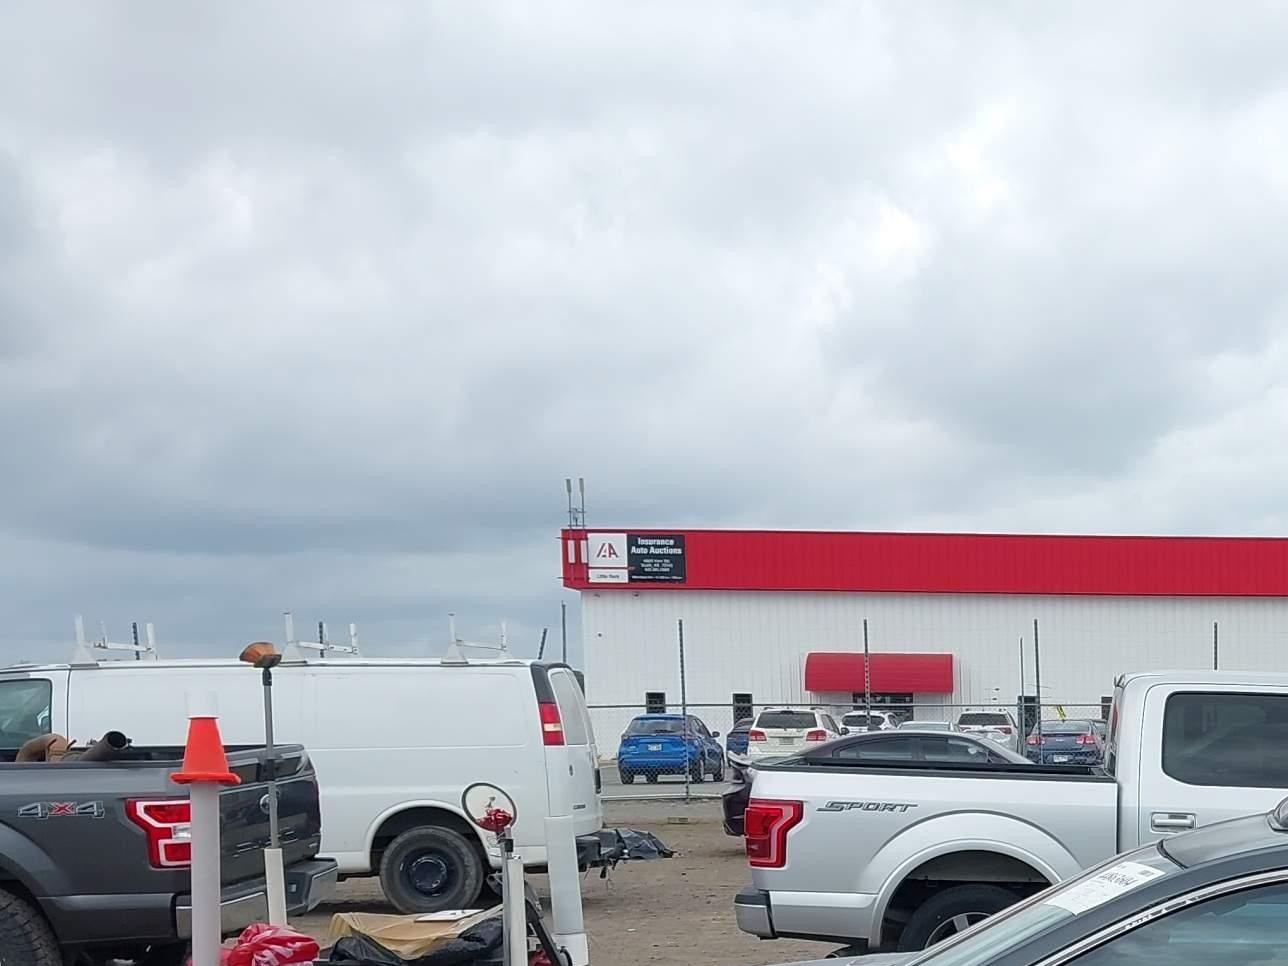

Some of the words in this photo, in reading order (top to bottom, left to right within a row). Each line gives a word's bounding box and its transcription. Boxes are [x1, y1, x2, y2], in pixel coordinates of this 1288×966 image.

[637, 537, 675, 546] Insurance
[630, 546, 648, 555] Auto
[649, 546, 682, 555] Auctions
[816, 801, 918, 813] SPORT
